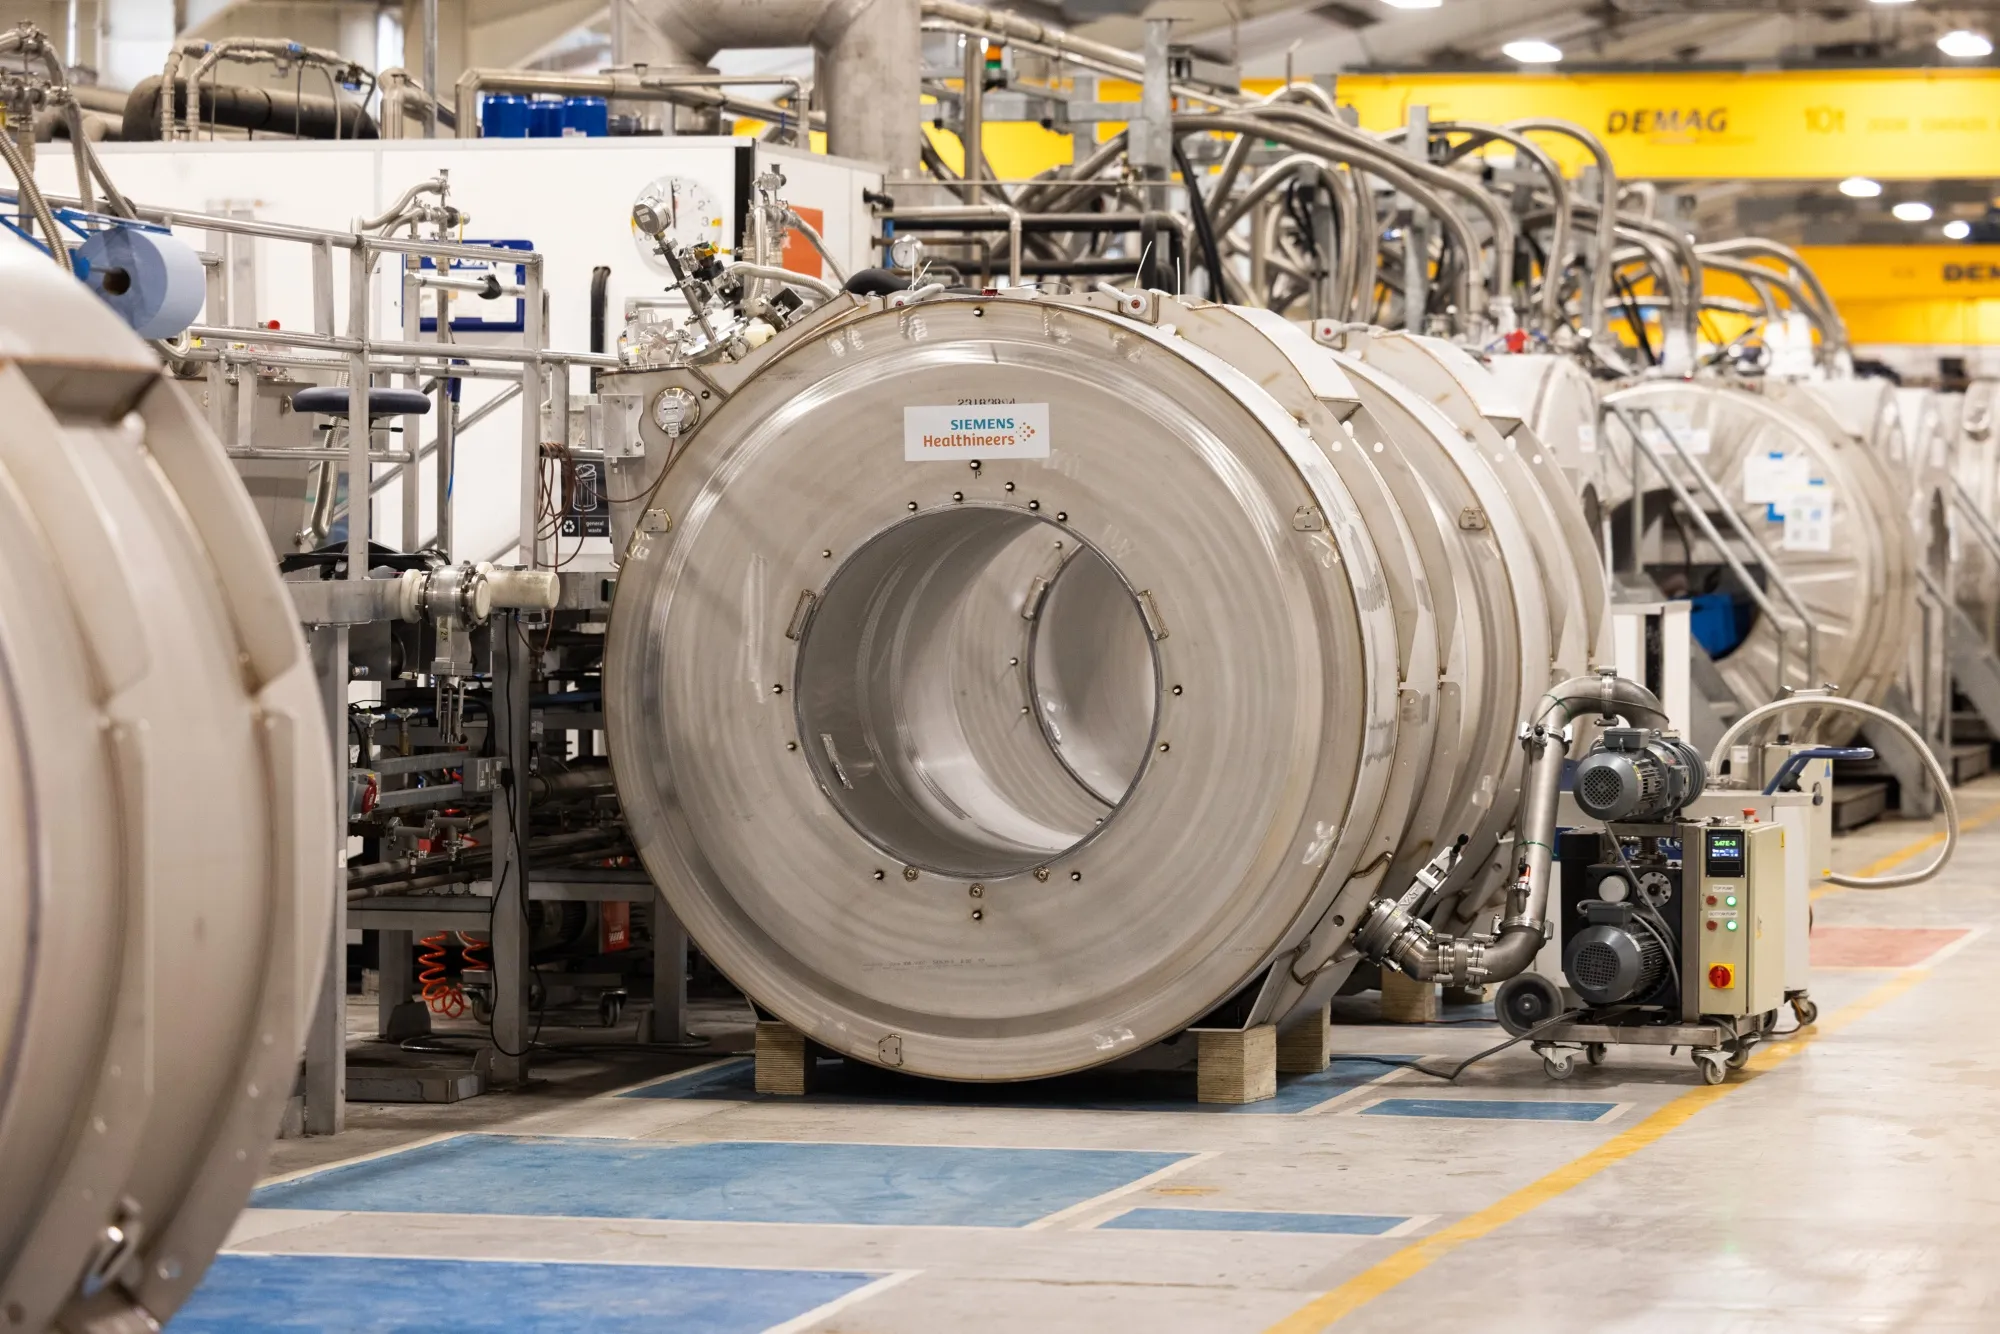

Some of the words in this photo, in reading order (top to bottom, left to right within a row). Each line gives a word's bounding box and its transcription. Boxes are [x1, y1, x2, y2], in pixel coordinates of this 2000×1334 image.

[1607, 107, 1728, 134] DEMAG
[697, 200, 706, 211] 2
[701, 216, 709, 227] 3
[951, 417, 1015, 430] SIEMENS
[923, 432, 1015, 447] Healthineers
